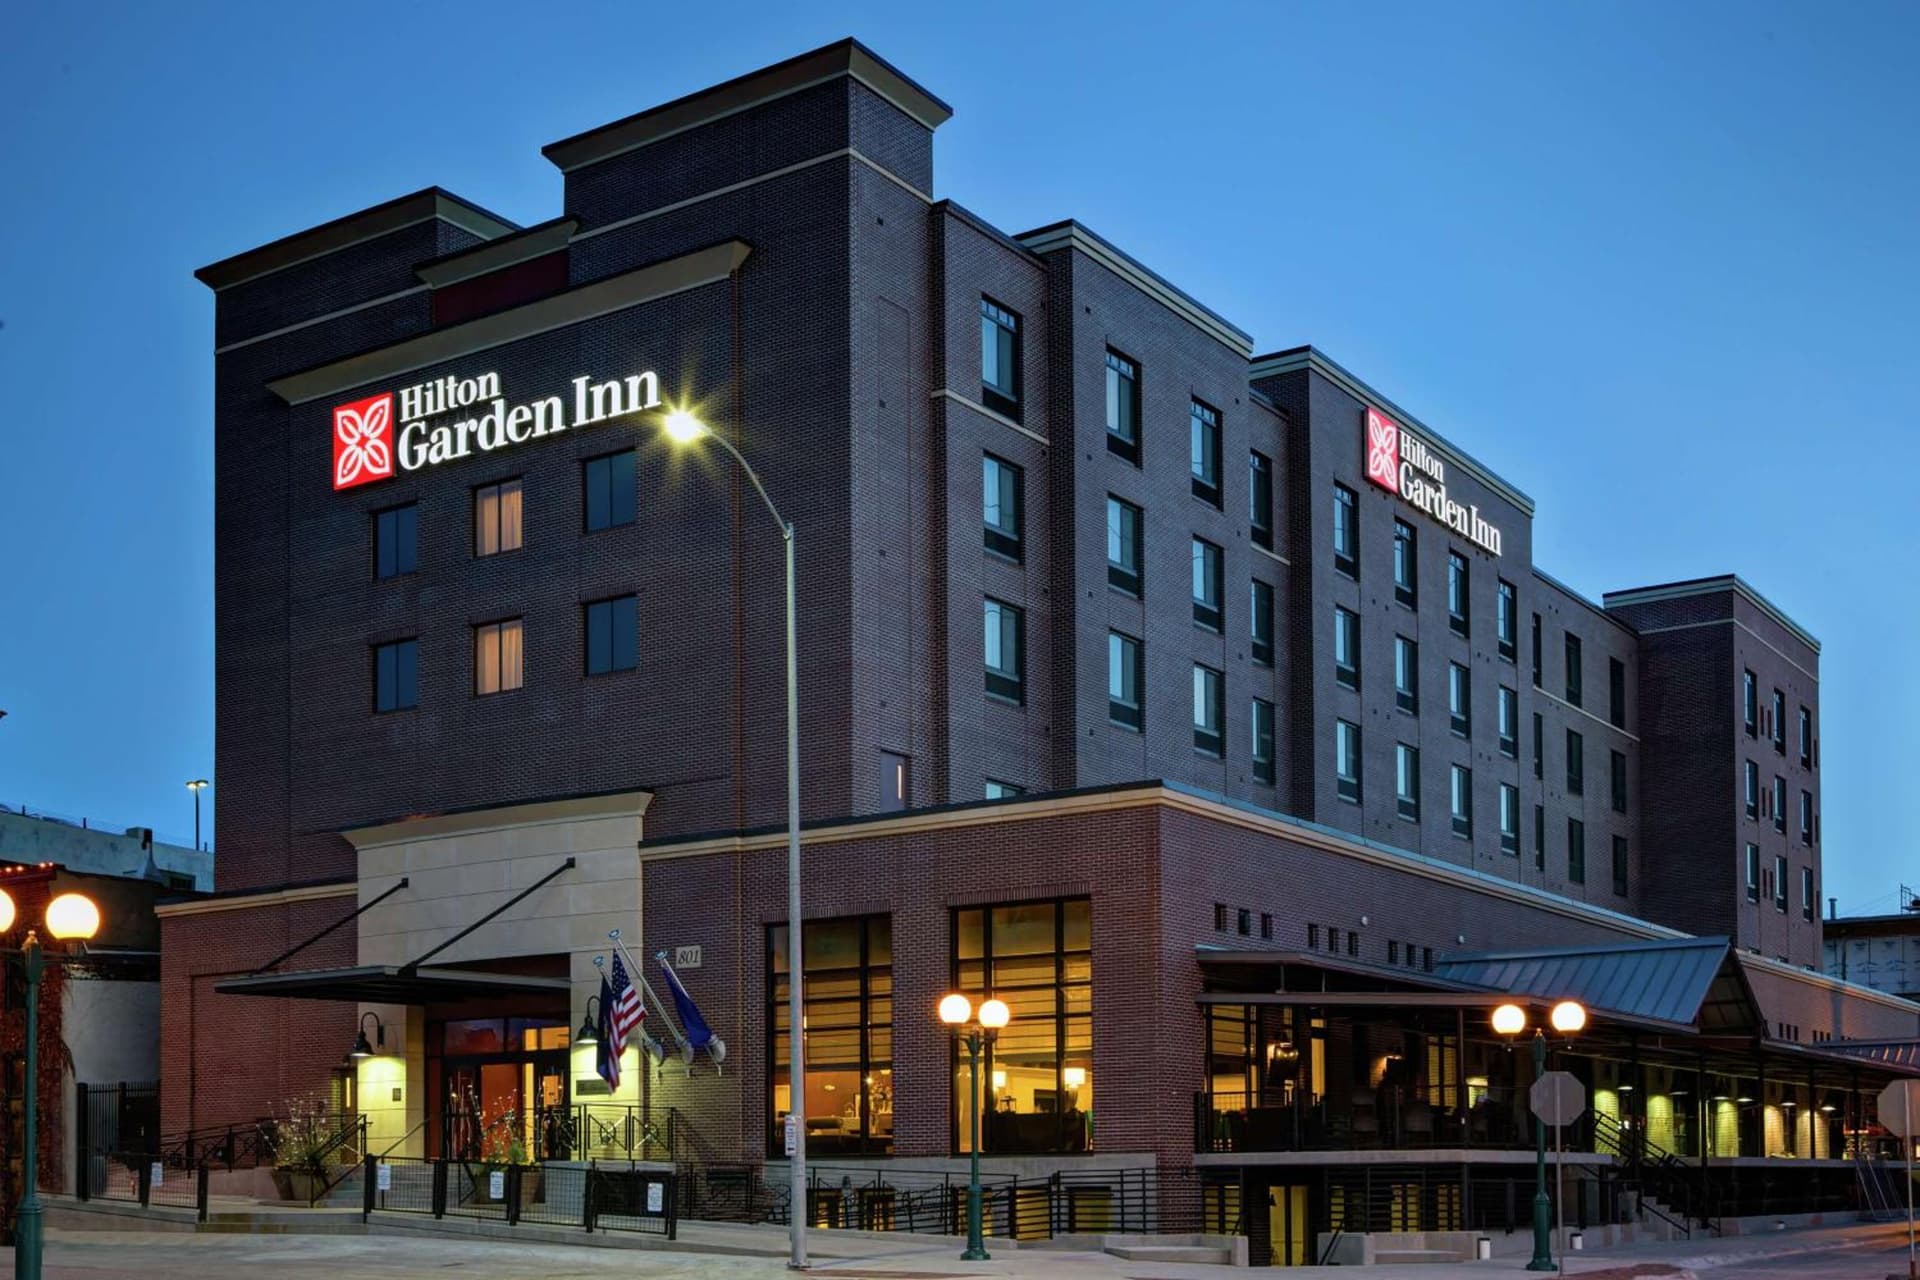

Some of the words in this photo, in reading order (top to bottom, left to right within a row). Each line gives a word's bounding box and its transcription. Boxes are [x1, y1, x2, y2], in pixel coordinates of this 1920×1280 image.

[398, 396, 566, 471] Garden
[571, 370, 662, 428] Inn
[399, 371, 500, 423] Hilton
[1399, 430, 1444, 483] Hilton
[1399, 461, 1470, 539] Garden
[1469, 505, 1502, 557] Inn
[678, 950, 699, 964] 801
